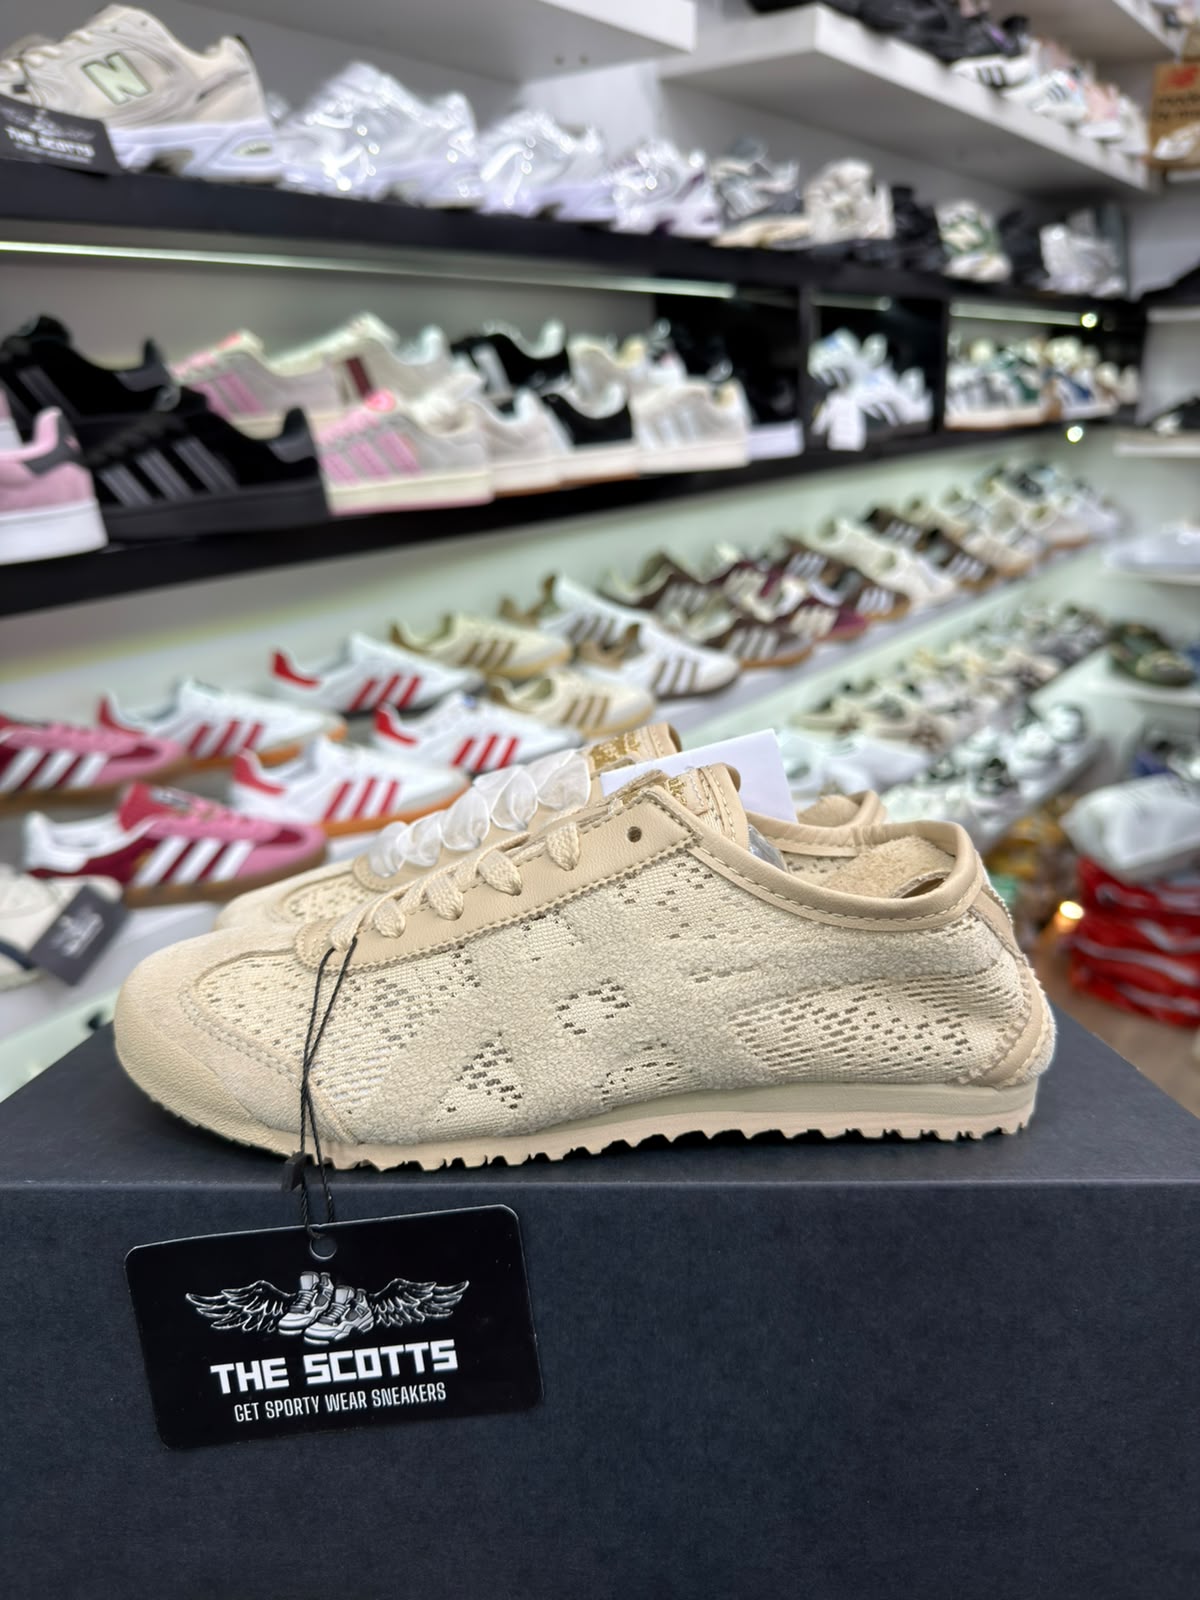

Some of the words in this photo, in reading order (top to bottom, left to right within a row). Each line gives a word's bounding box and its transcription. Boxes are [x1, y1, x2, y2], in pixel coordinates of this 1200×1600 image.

[81, 51, 153, 105] N
[209, 1357, 290, 1395] THE
[302, 1338, 459, 1385] SCOTTS
[234, 1400, 261, 1423] GET
[264, 1395, 319, 1419] SPORTY
[324, 1389, 368, 1412] WEAR
[371, 1381, 447, 1407] SNEAKERS
